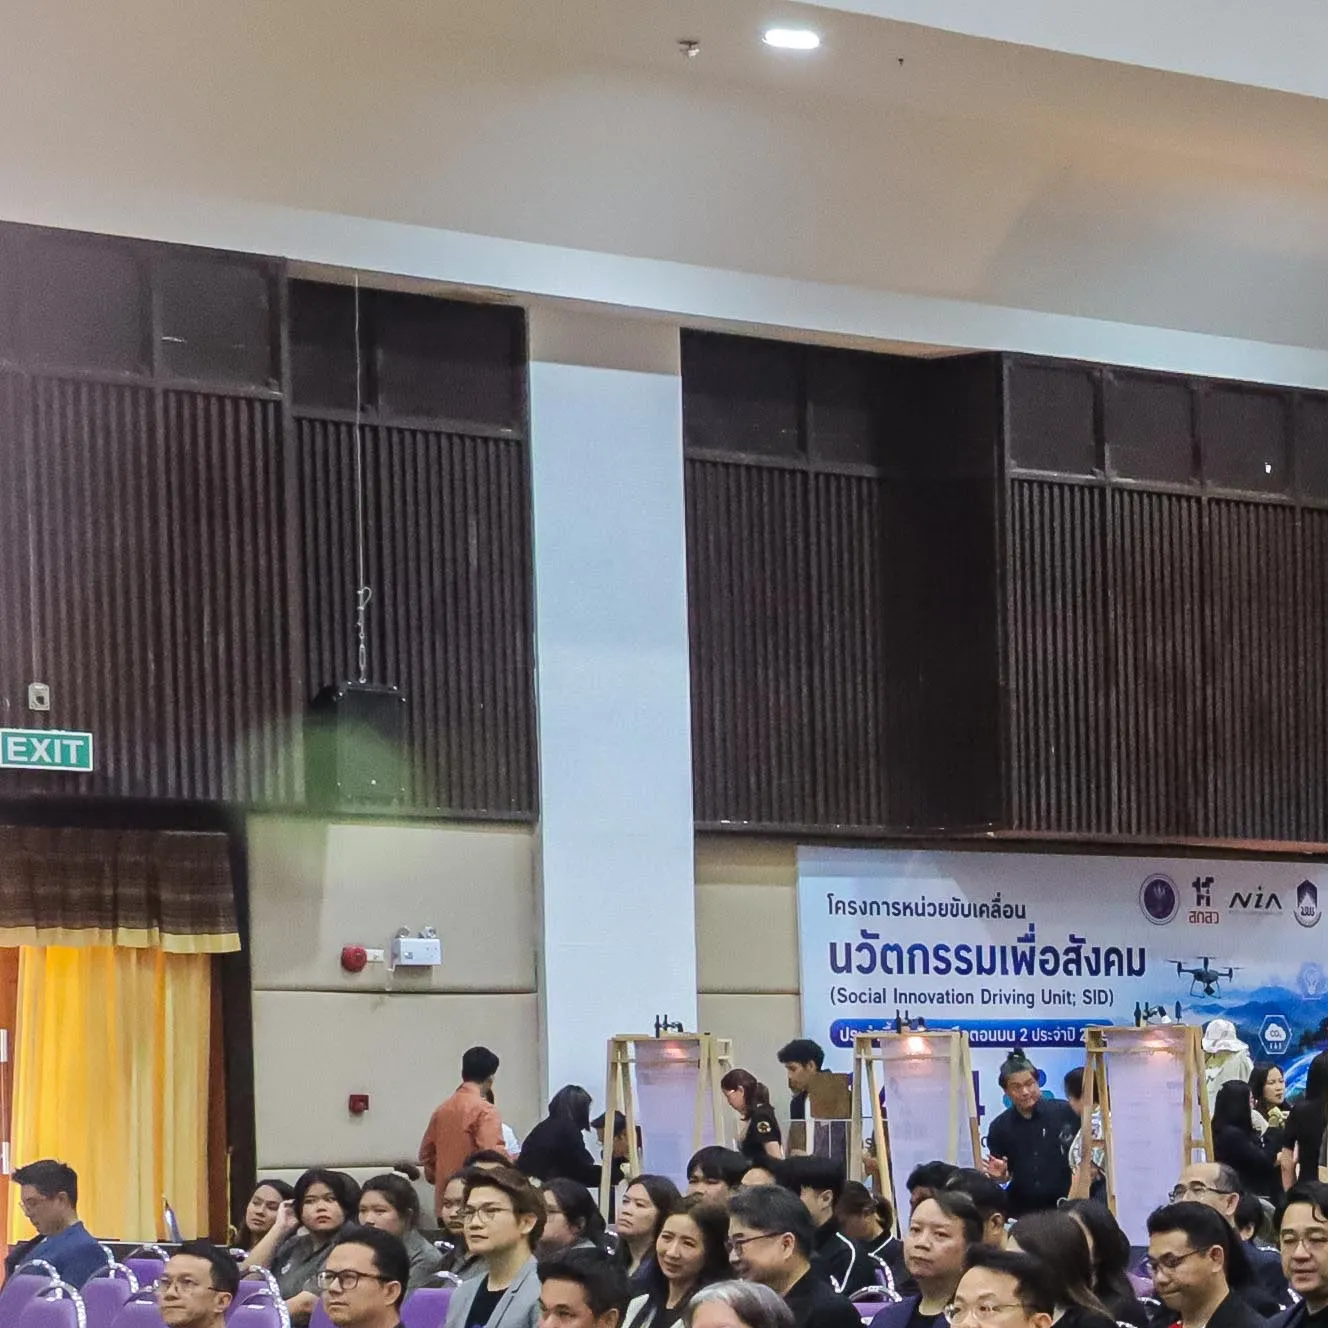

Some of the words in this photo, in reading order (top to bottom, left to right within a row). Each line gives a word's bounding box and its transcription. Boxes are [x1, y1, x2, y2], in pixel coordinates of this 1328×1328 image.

[6, 736, 85, 765] EXIT
[827, 892, 1027, 919] โครงการหน่วยขับเคลื่อน
[828, 922, 1147, 977] นวัตกรรมเพื่อสังคม
[830, 986, 886, 1006] (Social
[894, 988, 974, 1005] Innovation
[981, 988, 1034, 1008] Driving
[1041, 989, 1076, 1007] Unit;
[1083, 988, 1114, 1008] SID)
[1020, 1030, 1028, 1042] 2
